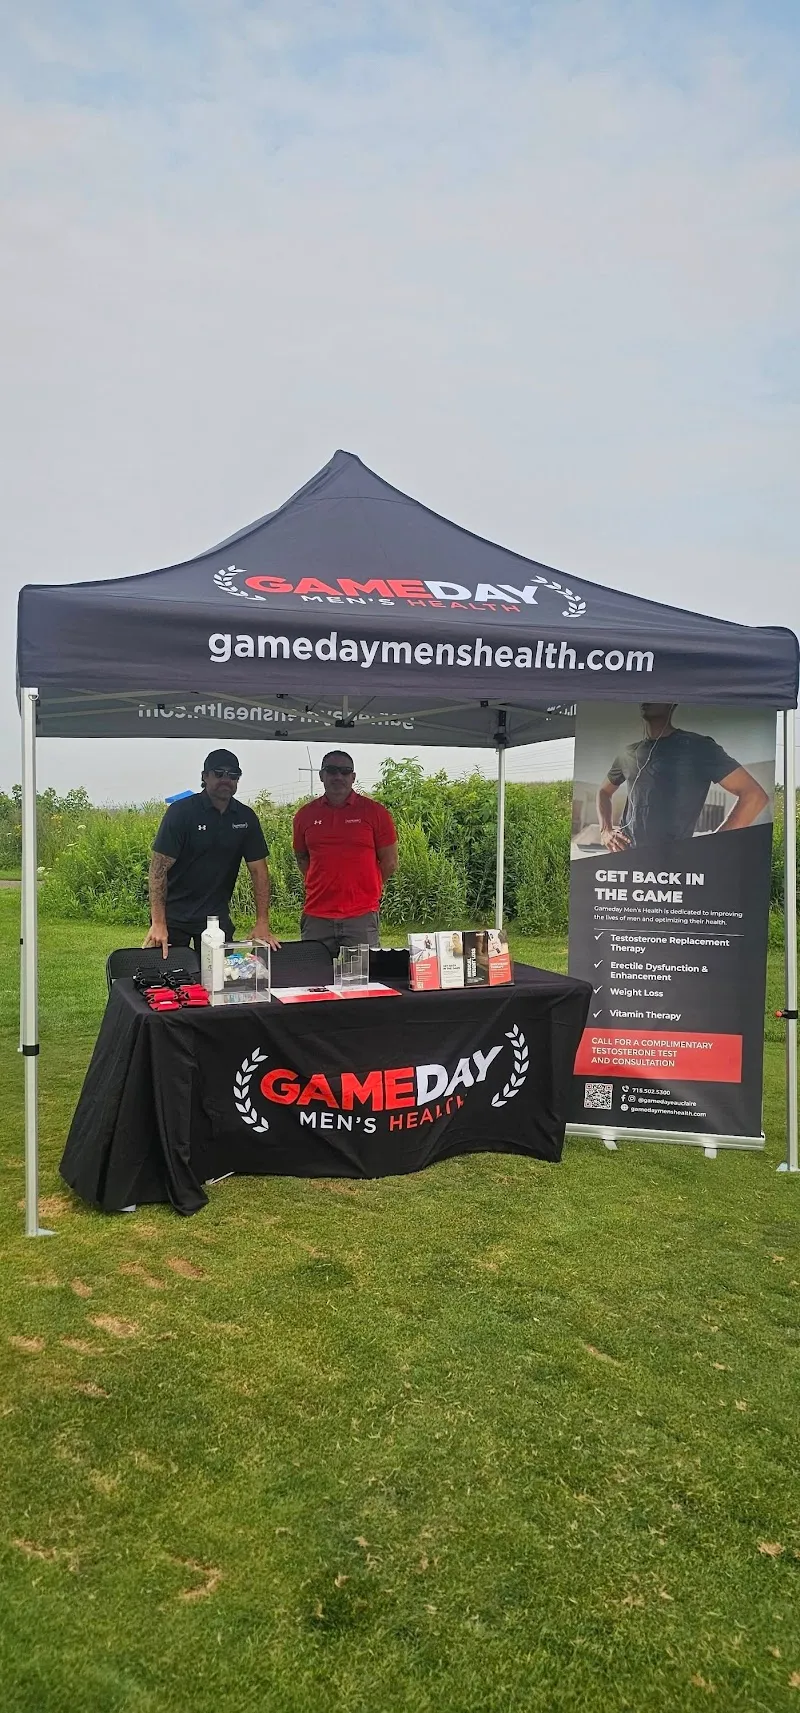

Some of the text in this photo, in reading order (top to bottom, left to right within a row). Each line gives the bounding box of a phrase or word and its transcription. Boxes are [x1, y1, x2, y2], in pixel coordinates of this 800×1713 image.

[245, 575, 539, 605] GAMEDAY
[301, 595, 521, 613] MEN'S HEALTH
[208, 631, 655, 672] gamedaymenshealth.com
[595, 870, 704, 886] GET BACK IN
[594, 888, 683, 903] THE GAME
[710, 910, 743, 918] improving
[611, 934, 730, 946] Testosterone Replacement
[611, 944, 646, 954] Therapy
[610, 961, 643, 970] Erectile
[646, 963, 699, 972] Dysfunction
[610, 972, 671, 981] Enhancement
[610, 988, 664, 997] Weight Loss
[610, 1010, 681, 1021] Vitamin Therapy
[592, 1037, 612, 1046] CALL
[641, 1040, 713, 1049] COMPLIMENTARY
[592, 1047, 656, 1057] TESTOSTERONE
[612, 1058, 675, 1067] CONSULTATION
[260, 1046, 504, 1111] GAMEDAY
[631, 1107, 707, 1117] gamedaymenshealth.com
[300, 1111, 376, 1134] MEN'S
